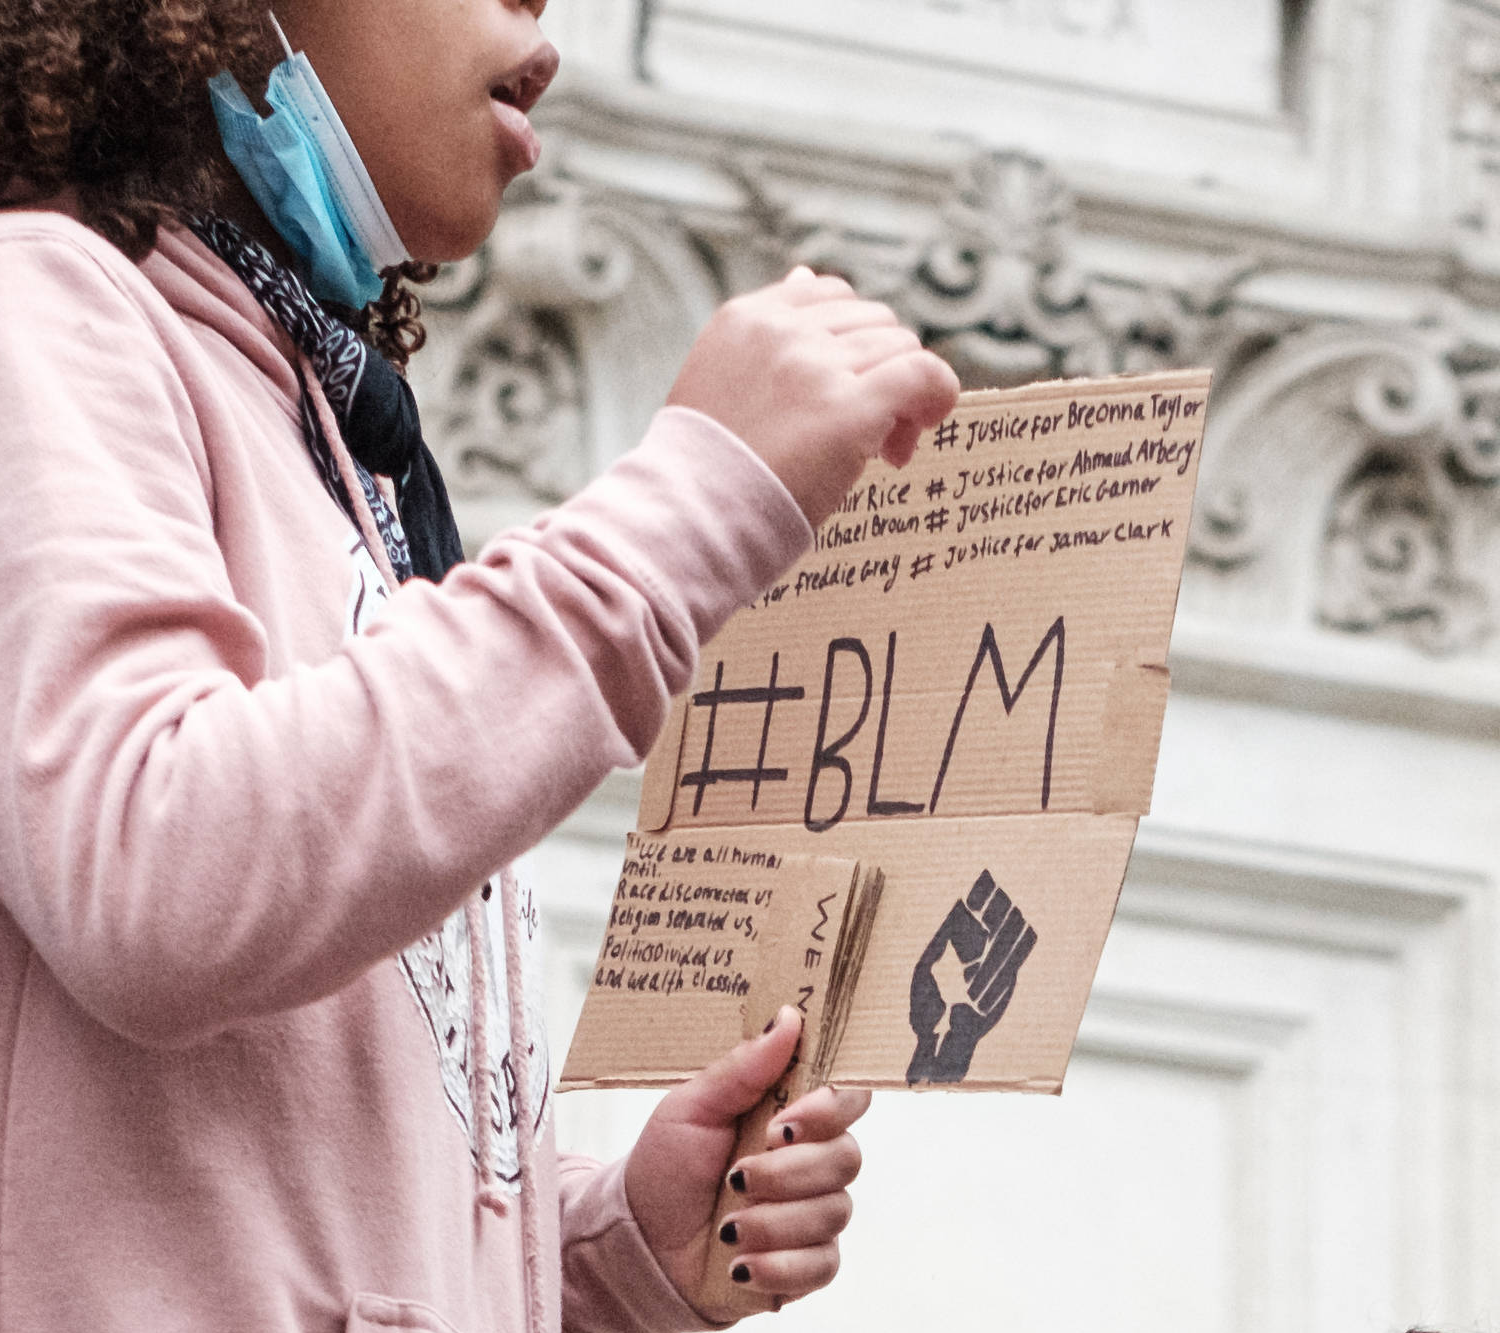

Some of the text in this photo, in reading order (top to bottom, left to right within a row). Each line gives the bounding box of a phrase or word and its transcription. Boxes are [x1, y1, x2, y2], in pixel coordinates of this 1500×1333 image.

[1151, 393, 1204, 432] Taylor
[867, 477, 911, 511] Rice
[1136, 437, 1196, 475] Arbery
[872, 514, 919, 537] Brown
[1055, 483, 1091, 509] Eric
[860, 554, 900, 593] Gray
[1114, 519, 1174, 543] Clark
[681, 615, 1068, 833] #BLM
[703, 845, 728, 864] all
[616, 878, 657, 902] Race
[610, 905, 661, 935] Religion
